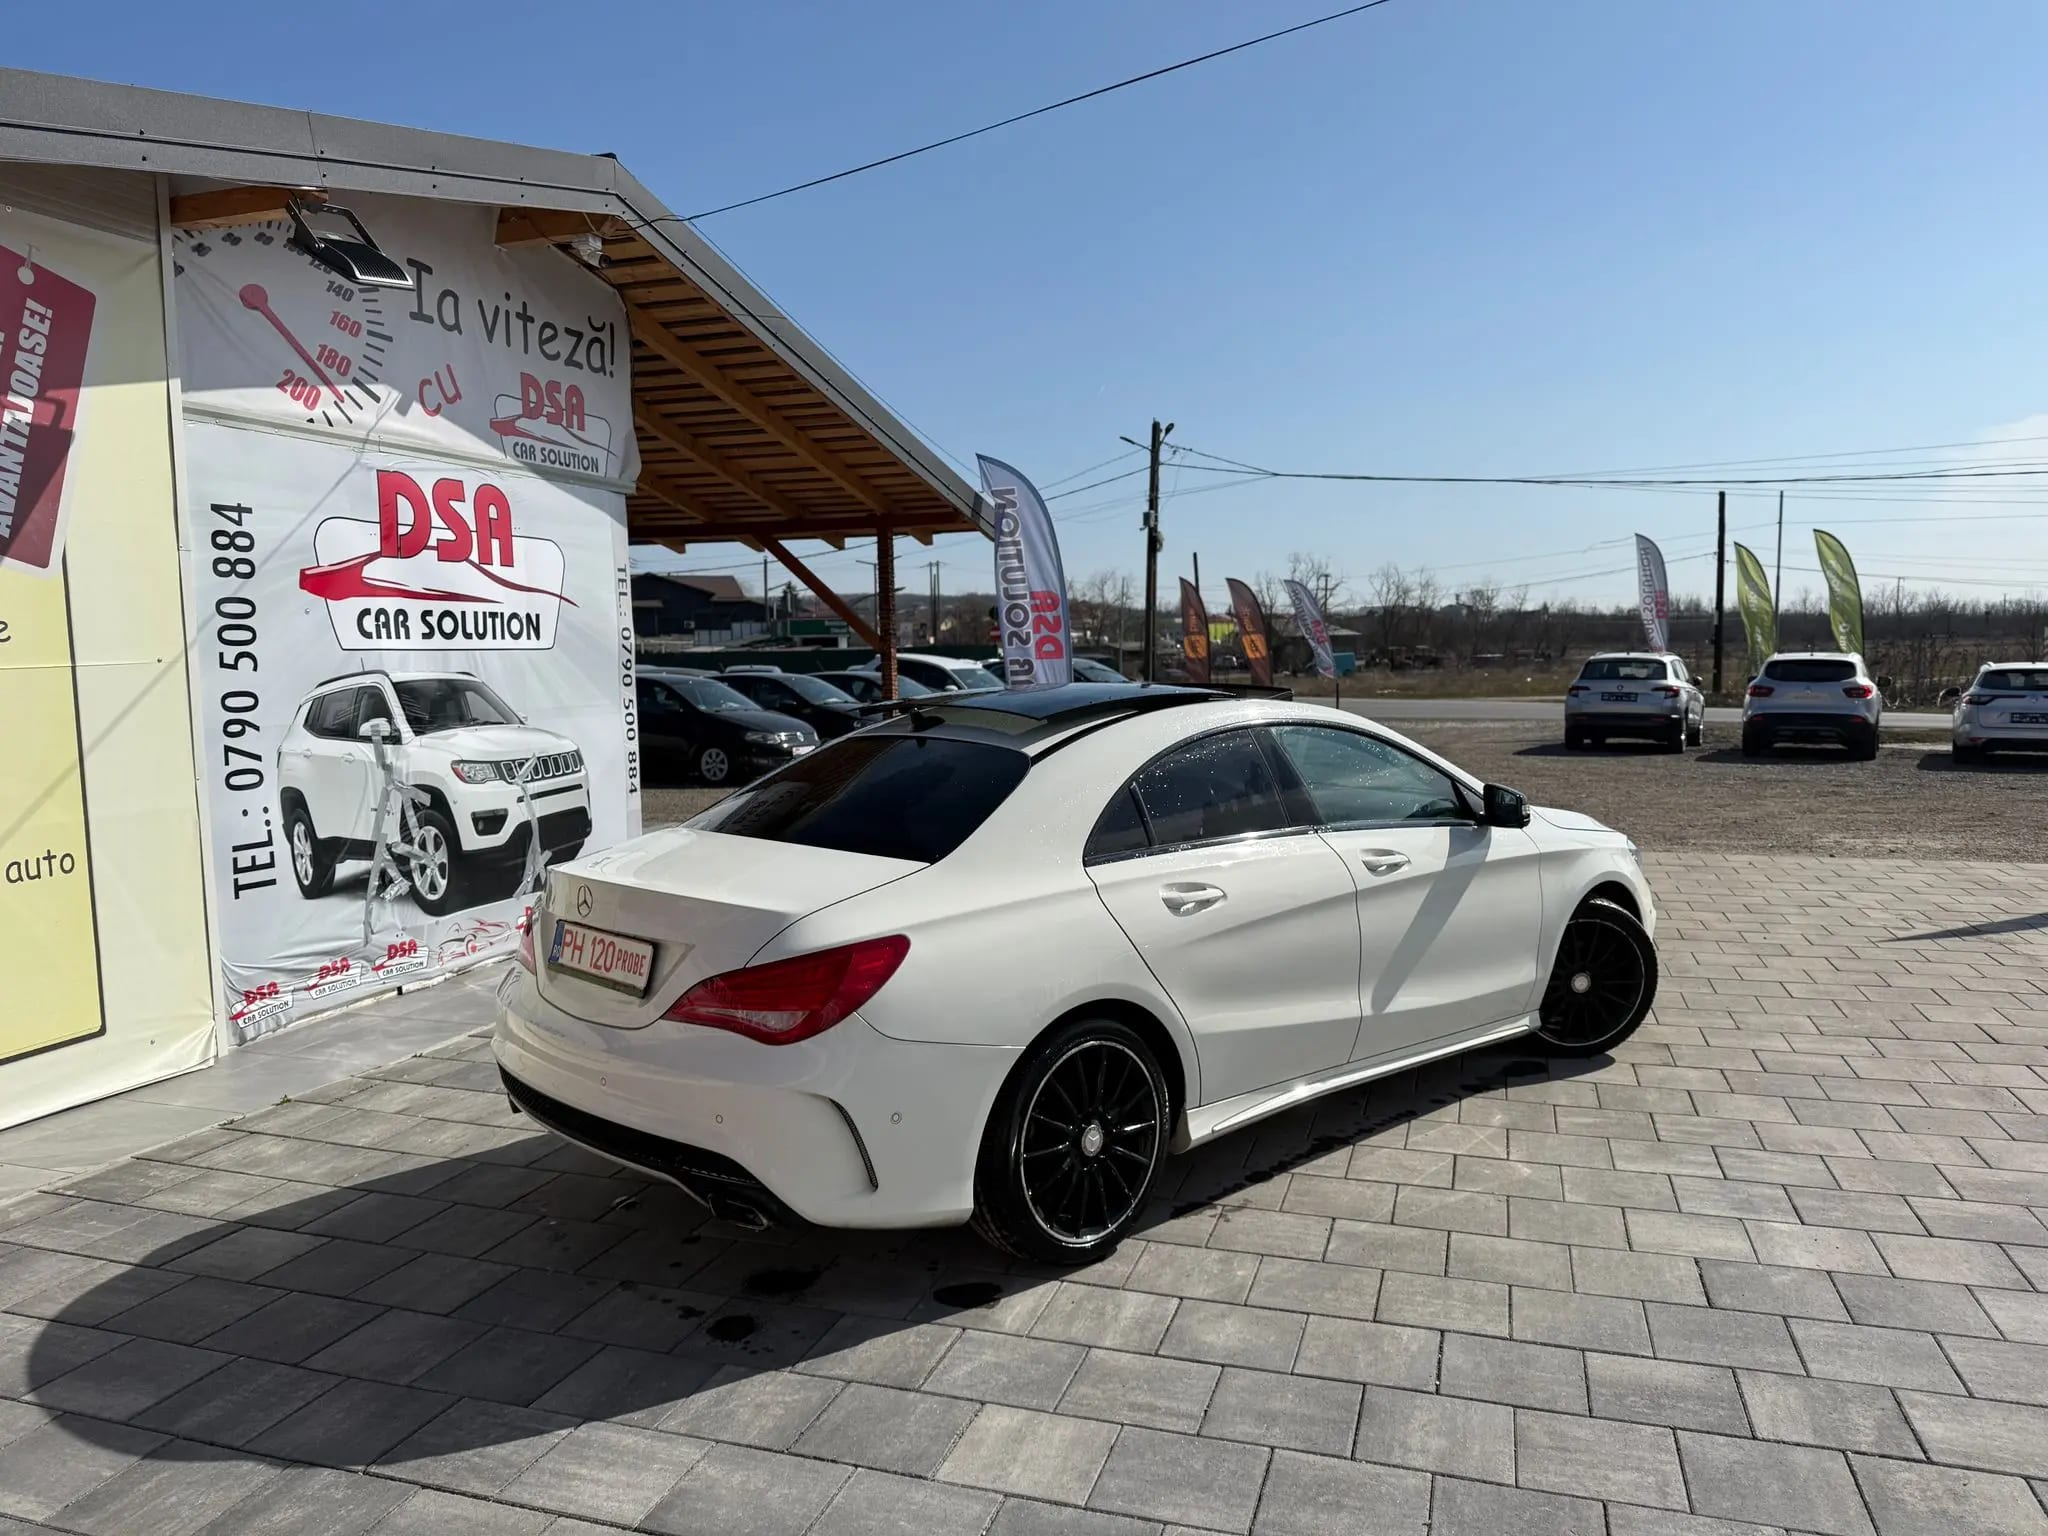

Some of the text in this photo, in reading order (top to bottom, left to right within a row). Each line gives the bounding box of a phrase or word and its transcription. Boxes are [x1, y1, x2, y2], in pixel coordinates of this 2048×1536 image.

[325, 280, 355, 303] 140
[328, 310, 363, 338] 160
[406, 257, 615, 379] Ia viteză!
[315, 343, 352, 377] 180
[276, 368, 322, 412] 200
[520, 371, 586, 432] DSA
[512, 441, 600, 474] CAR SOLUTION
[376, 468, 515, 568] DSA
[356, 607, 542, 641] CAR SOLUTION
[620, 625, 634, 688] 0790
[210, 502, 278, 900] TEL.: 0790 500 884
[622, 697, 638, 742] 500
[627, 750, 639, 796] 884
[5, 849, 76, 884] auto
[387, 938, 418, 960] DSA
[561, 928, 647, 977] PH 120 PROBE
[319, 956, 351, 980] DSA
[243, 981, 280, 1006] DSA
[257, 1000, 290, 1019] SOLUTION
